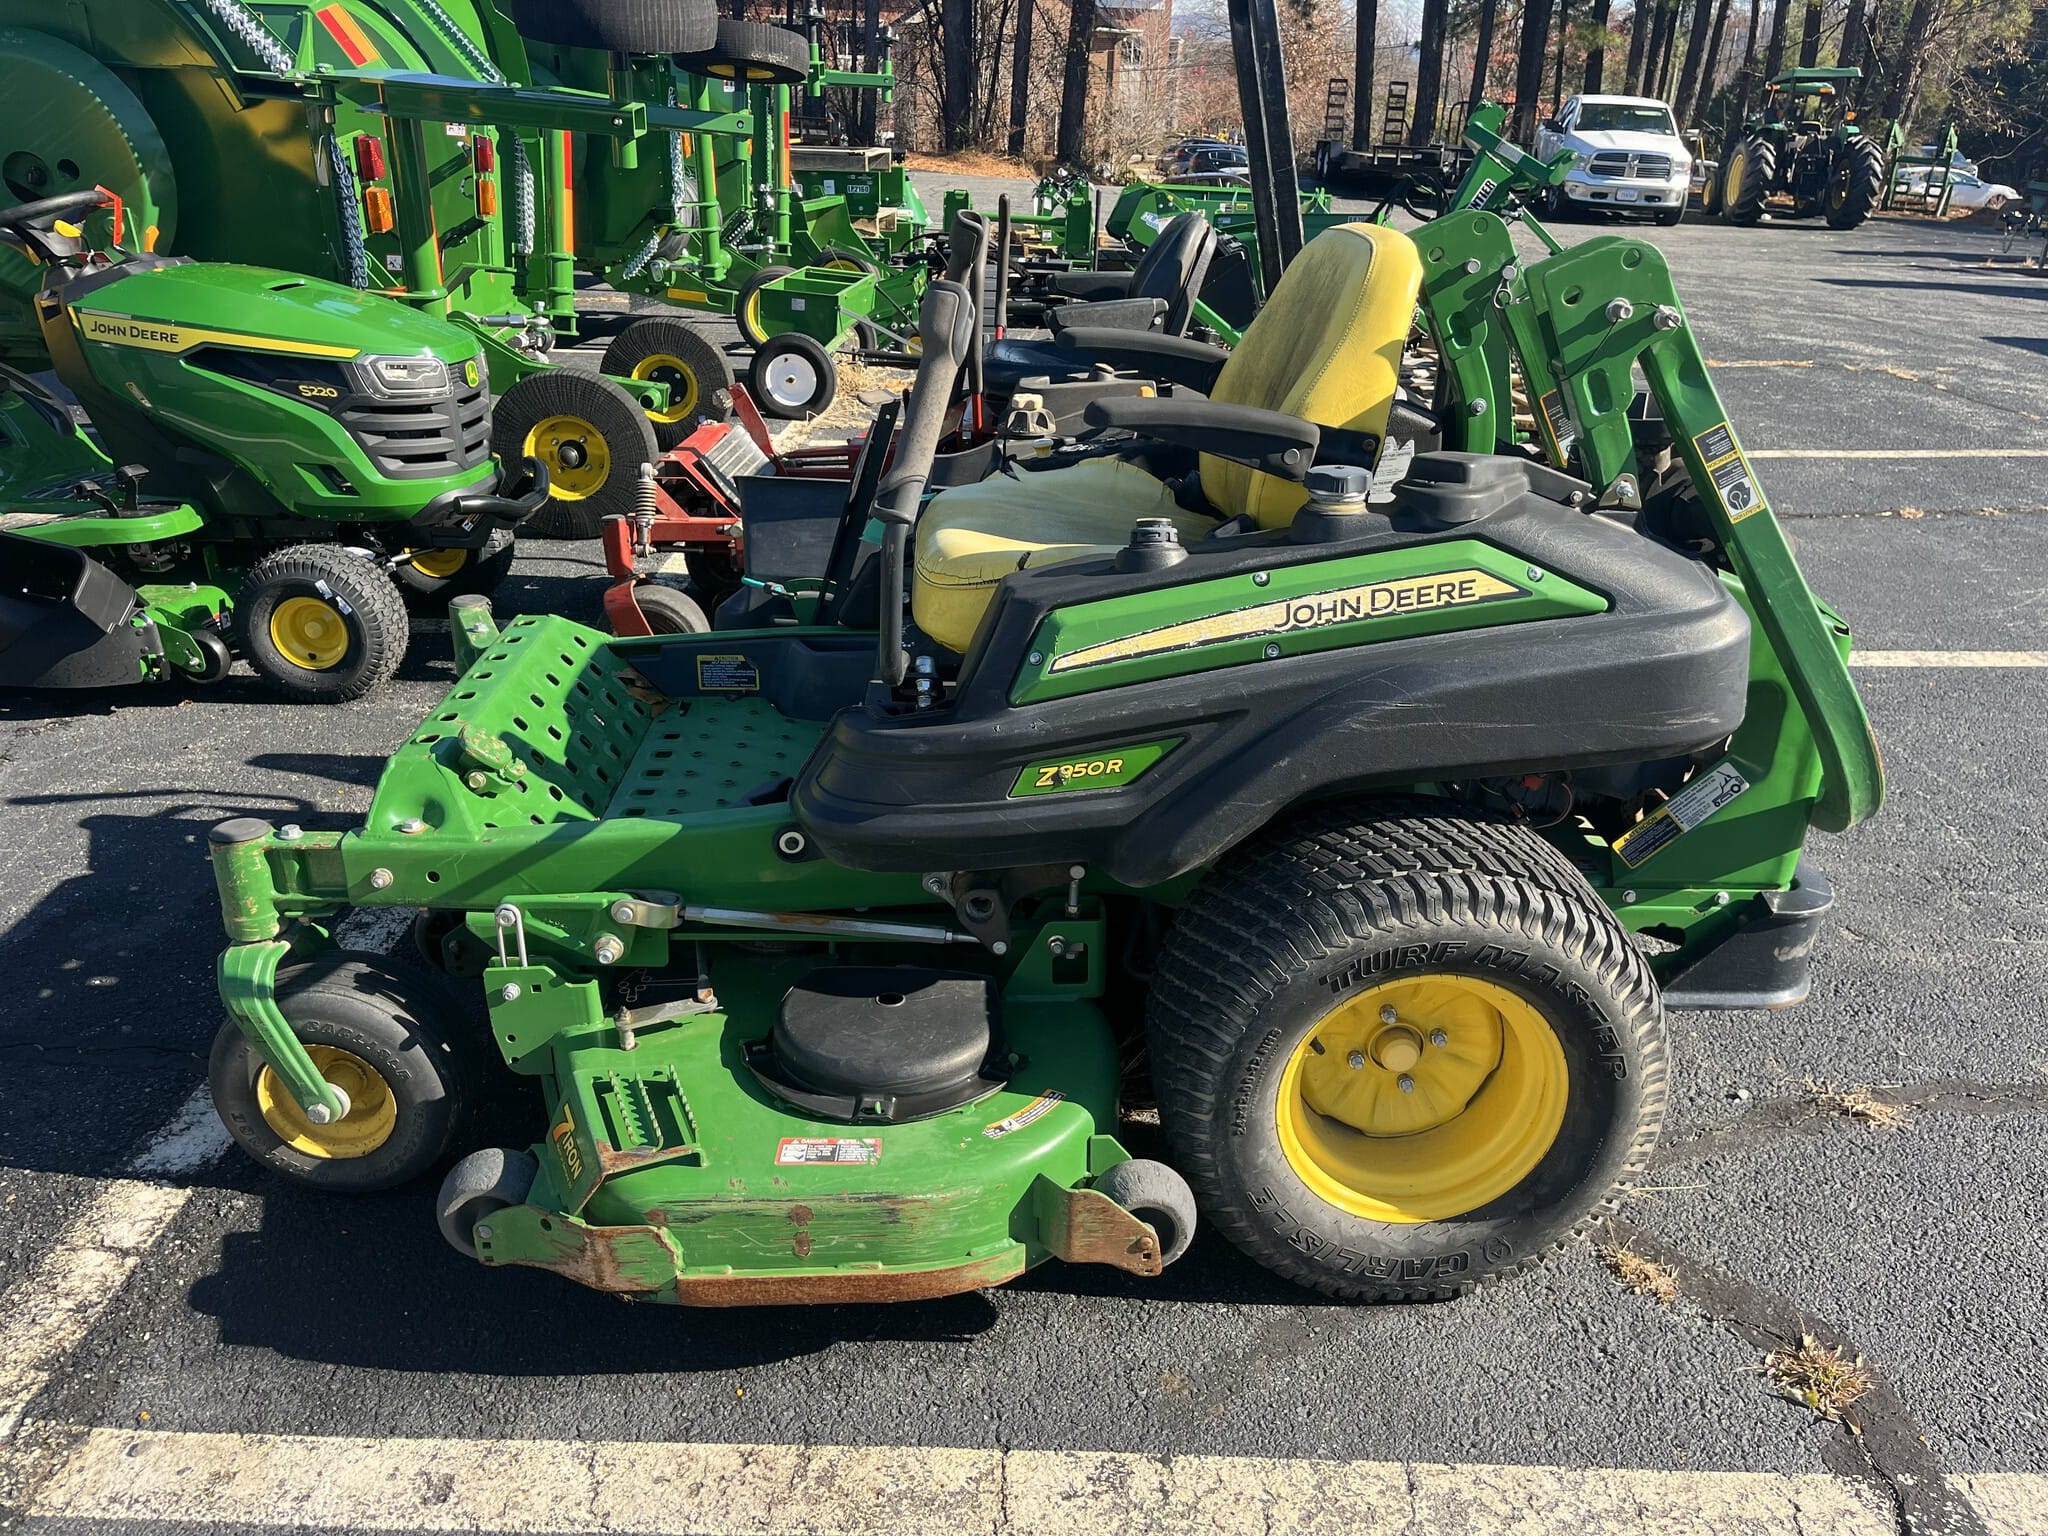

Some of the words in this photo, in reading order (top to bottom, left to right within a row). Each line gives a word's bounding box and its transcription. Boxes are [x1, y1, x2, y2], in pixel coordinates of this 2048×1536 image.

[90, 321, 126, 337] JOHN
[129, 326, 179, 344] DEERE
[299, 385, 338, 398] S220
[1274, 596, 1361, 628] JOHN
[1370, 578, 1477, 613] DEERE
[1034, 759, 1124, 787] Z950R
[1319, 941, 1468, 994] TURF
[1474, 944, 1628, 1081] MASTER
[304, 1020, 412, 1081] CARLISLE
[1247, 1184, 1470, 1280] CARLISLE
